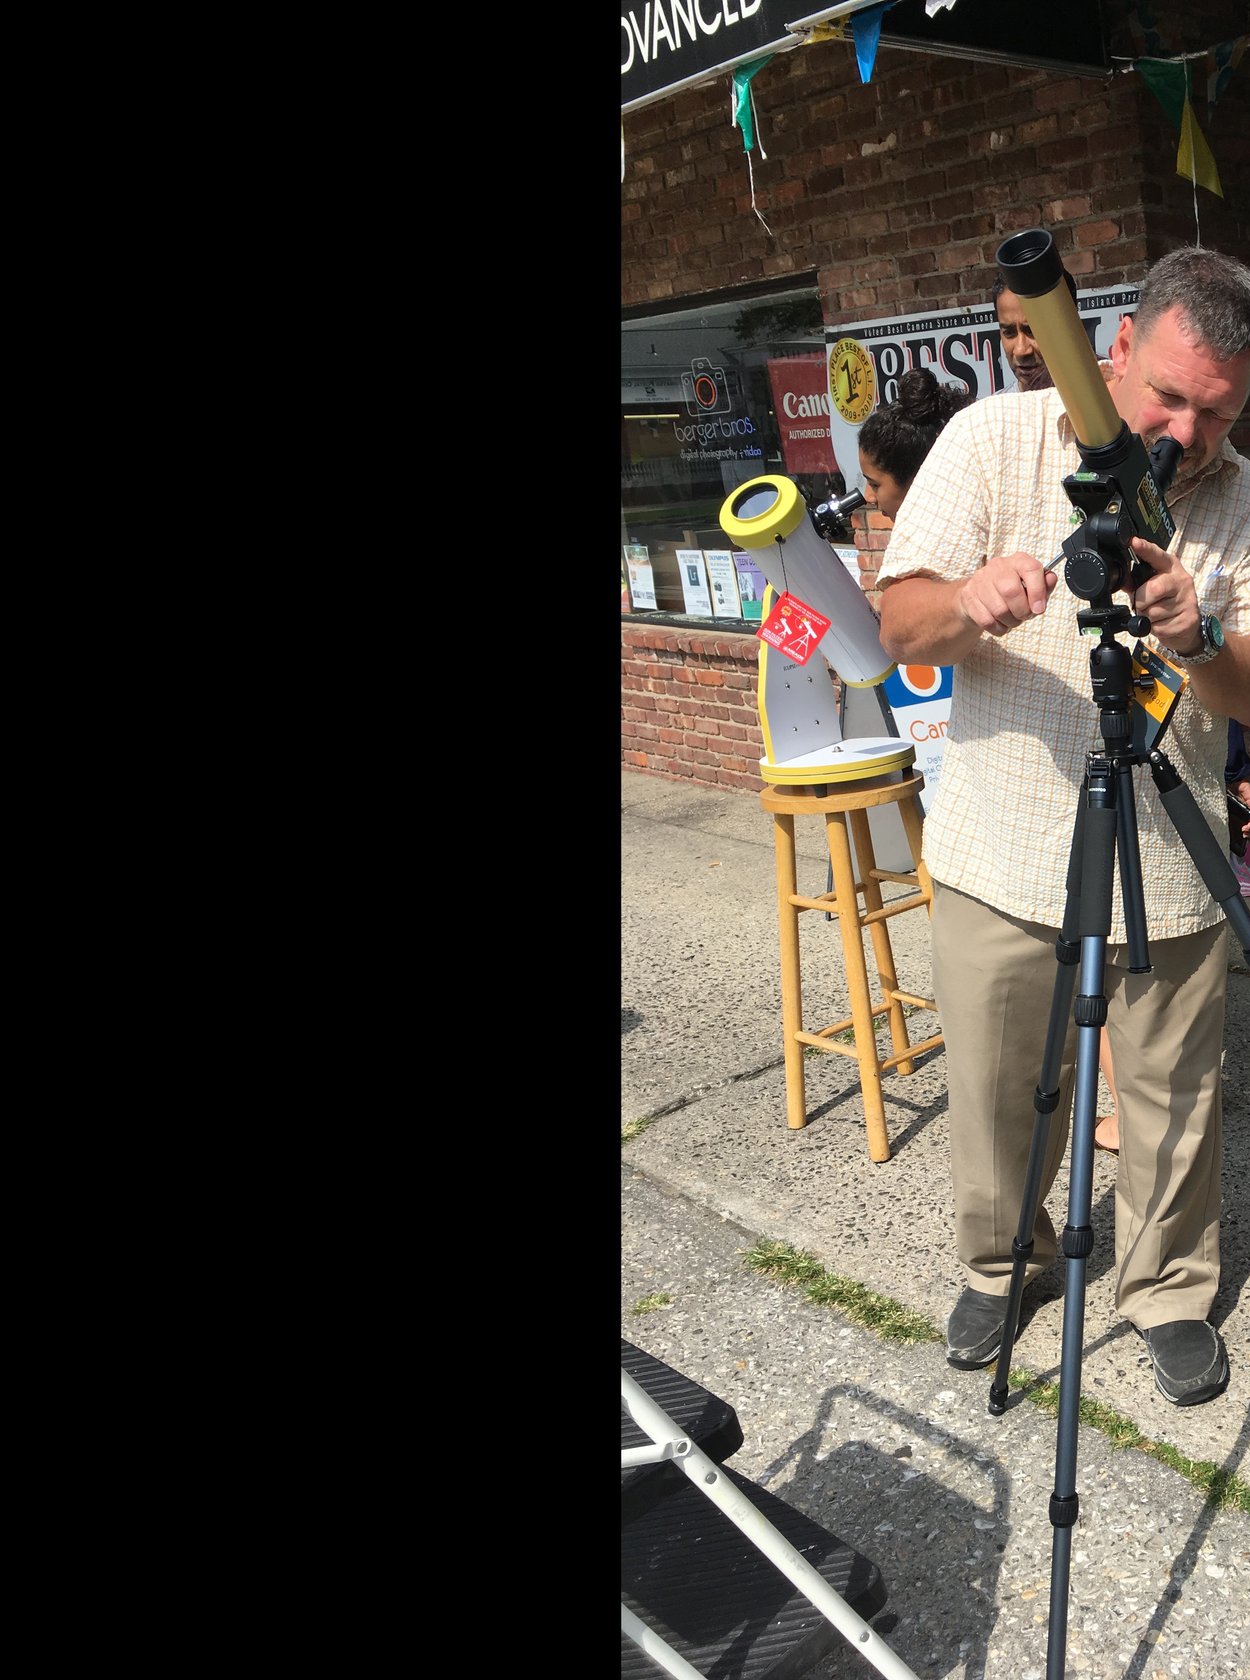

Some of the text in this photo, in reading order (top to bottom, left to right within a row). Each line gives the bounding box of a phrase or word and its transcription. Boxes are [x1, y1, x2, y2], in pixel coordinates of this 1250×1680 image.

[621, 0, 761, 74] DVANCE
[1086, 296, 1116, 308] Island
[1122, 293, 1141, 304] Pres
[887, 323, 903, 334] Best
[906, 321, 933, 332] Camera
[937, 318, 957, 328] Store
[962, 316, 971, 325] on
[975, 313, 994, 323] Long
[831, 344, 846, 370] PLACE
[845, 342, 861, 356] BEST
[860, 354, 870, 367] OF
[840, 358, 862, 404] 1st
[783, 392, 831, 419] Cano
[840, 393, 873, 420] 2009-2010
[789, 428, 832, 440] AUTHORIZED D
